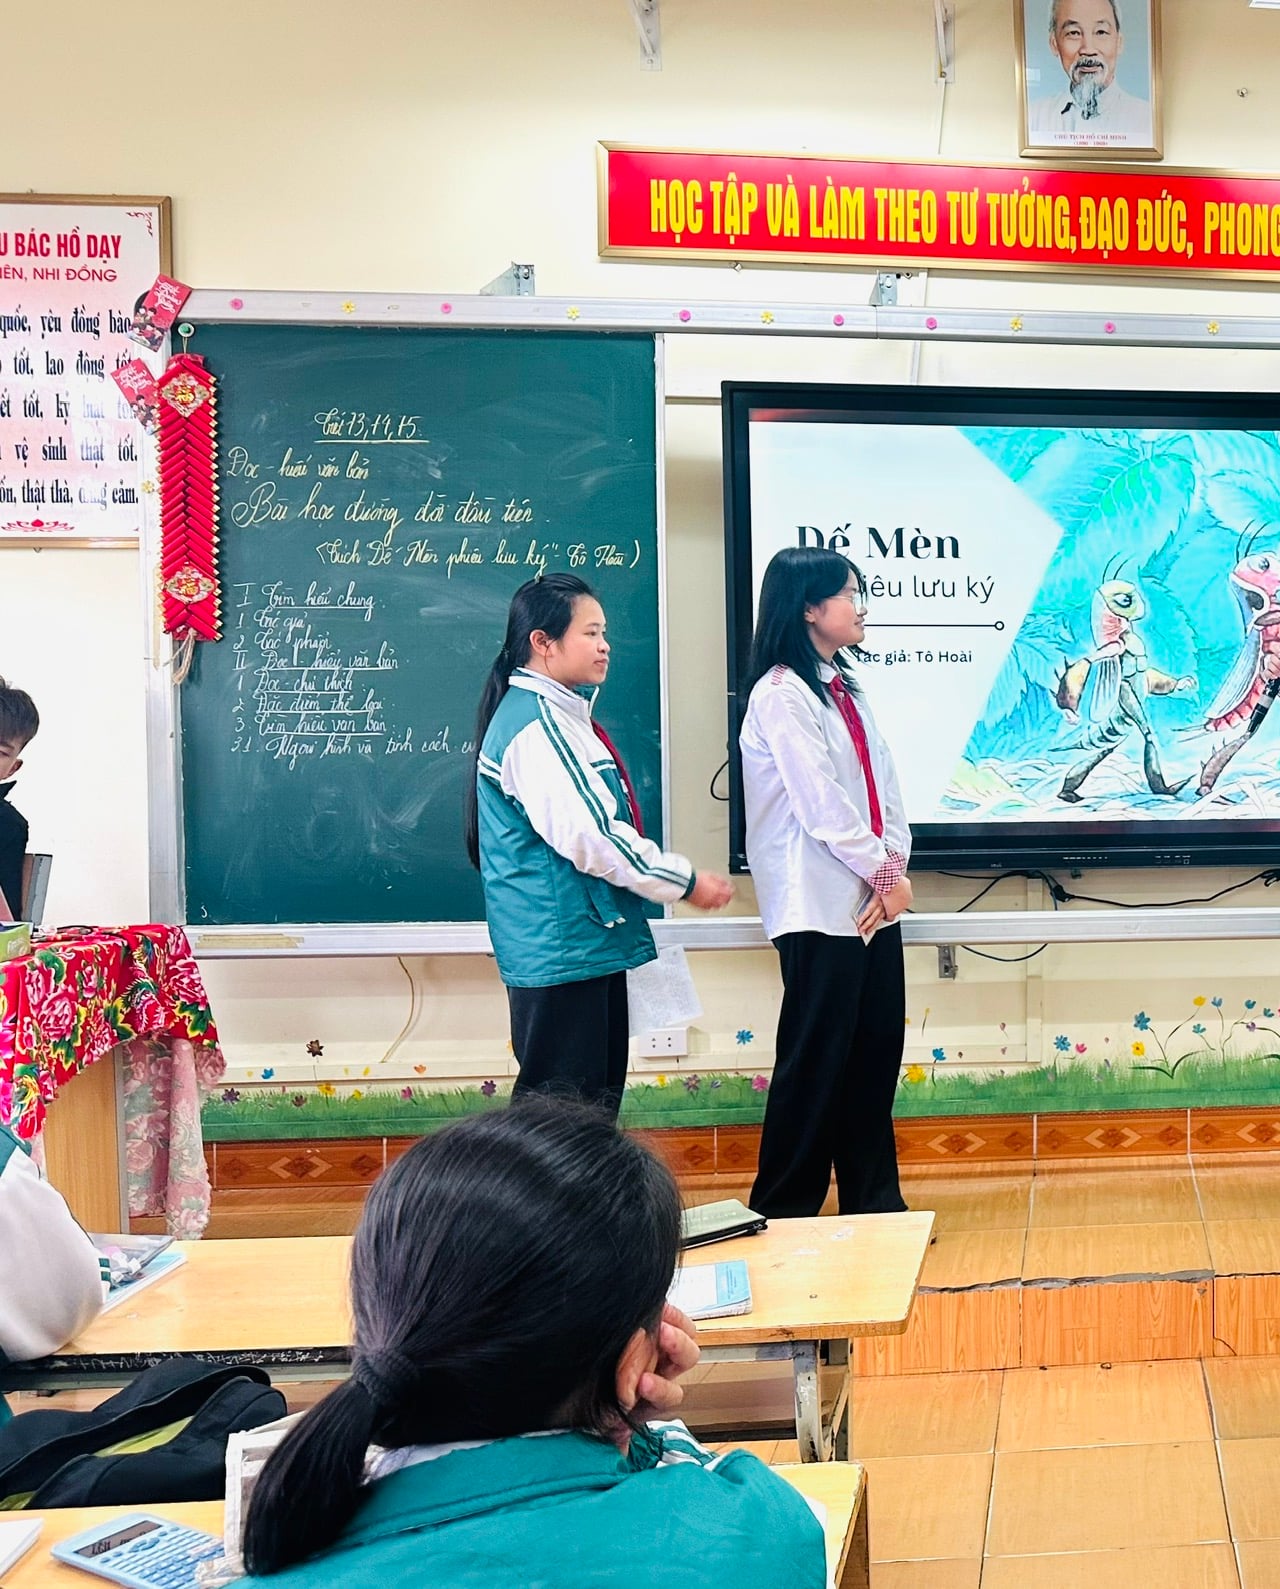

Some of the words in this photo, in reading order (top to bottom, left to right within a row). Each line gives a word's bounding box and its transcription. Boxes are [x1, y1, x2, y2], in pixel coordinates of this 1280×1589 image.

[650, 178, 703, 244] HỌC
[709, 171, 759, 245] TẬP
[766, 174, 800, 238] VÀ
[809, 176, 865, 241] LÀM
[874, 187, 937, 244] THEO
[946, 187, 980, 246] TƯ
[1136, 189, 1194, 260] ĐỨC,
[14, 228, 51, 257] BÁC
[56, 226, 81, 257] HỒ
[87, 234, 122, 264] DẠY
[33, 267, 60, 281] NHI
[65, 263, 118, 282] ĐỒNG
[40, 309, 62, 339] yêu
[71, 304, 101, 340] đồng
[13, 346, 34, 378] tốt,
[45, 350, 64, 375] lao
[76, 349, 105, 383] động
[23, 389, 44, 422] tốt,
[15, 436, 29, 468] vệ
[42, 435, 67, 461] sinh
[118, 433, 138, 462] tốt.
[226, 446, 259, 484] Đọc
[318, 457, 340, 478] văn
[345, 450, 371, 479] bản
[22, 479, 46, 511] thật
[50, 479, 74, 507] thà,
[112, 479, 139, 504] cảm.
[231, 481, 289, 528] Bài
[297, 482, 336, 528] học
[344, 489, 405, 547] đường
[414, 490, 450, 523] đời
[454, 490, 497, 523] đầu
[403, 539, 439, 567] Mèn
[446, 537, 484, 579] phiêu
[491, 537, 519, 564] lưu
[795, 523, 852, 557] Dế
[865, 527, 962, 560] Mèn
[913, 574, 956, 598] lưu
[966, 574, 995, 604] ký
[348, 650, 370, 668] văn
[885, 648, 911, 667] giả:
[915, 650, 934, 663] Tô
[938, 650, 973, 663] Hoài
[320, 734, 352, 759] hình
[358, 739, 372, 754] và
[422, 725, 450, 754] cách
